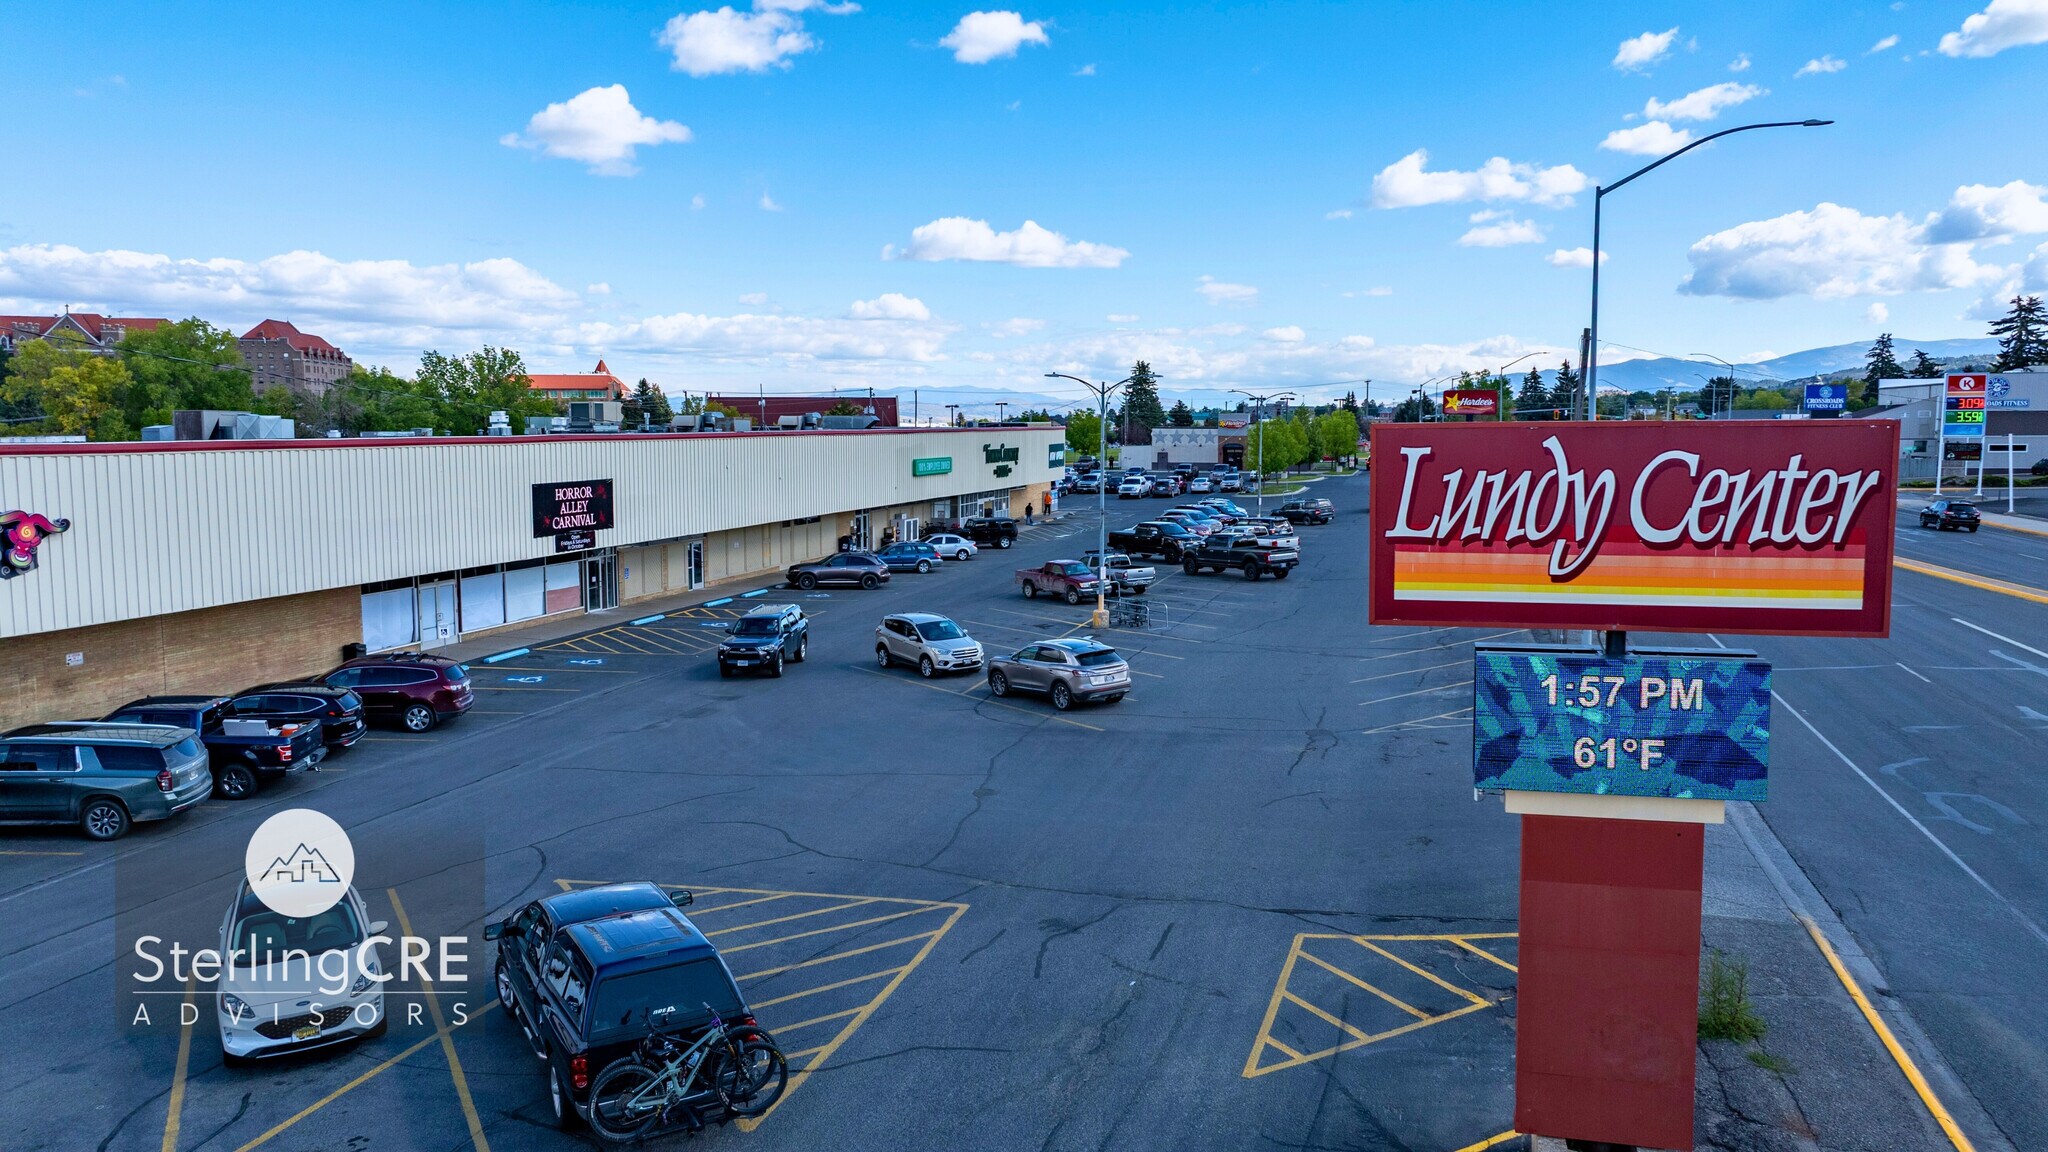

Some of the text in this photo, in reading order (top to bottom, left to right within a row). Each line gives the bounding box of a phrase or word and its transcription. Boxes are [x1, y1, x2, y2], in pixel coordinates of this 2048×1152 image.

[555, 486, 593, 501] HORROR
[1385, 434, 1881, 576] Lundy Center
[560, 500, 589, 515] ALLEY
[552, 513, 597, 530] CARNIVAL
[1540, 674, 1704, 711] 1:57 PM
[1573, 736, 1666, 771] 61°F
